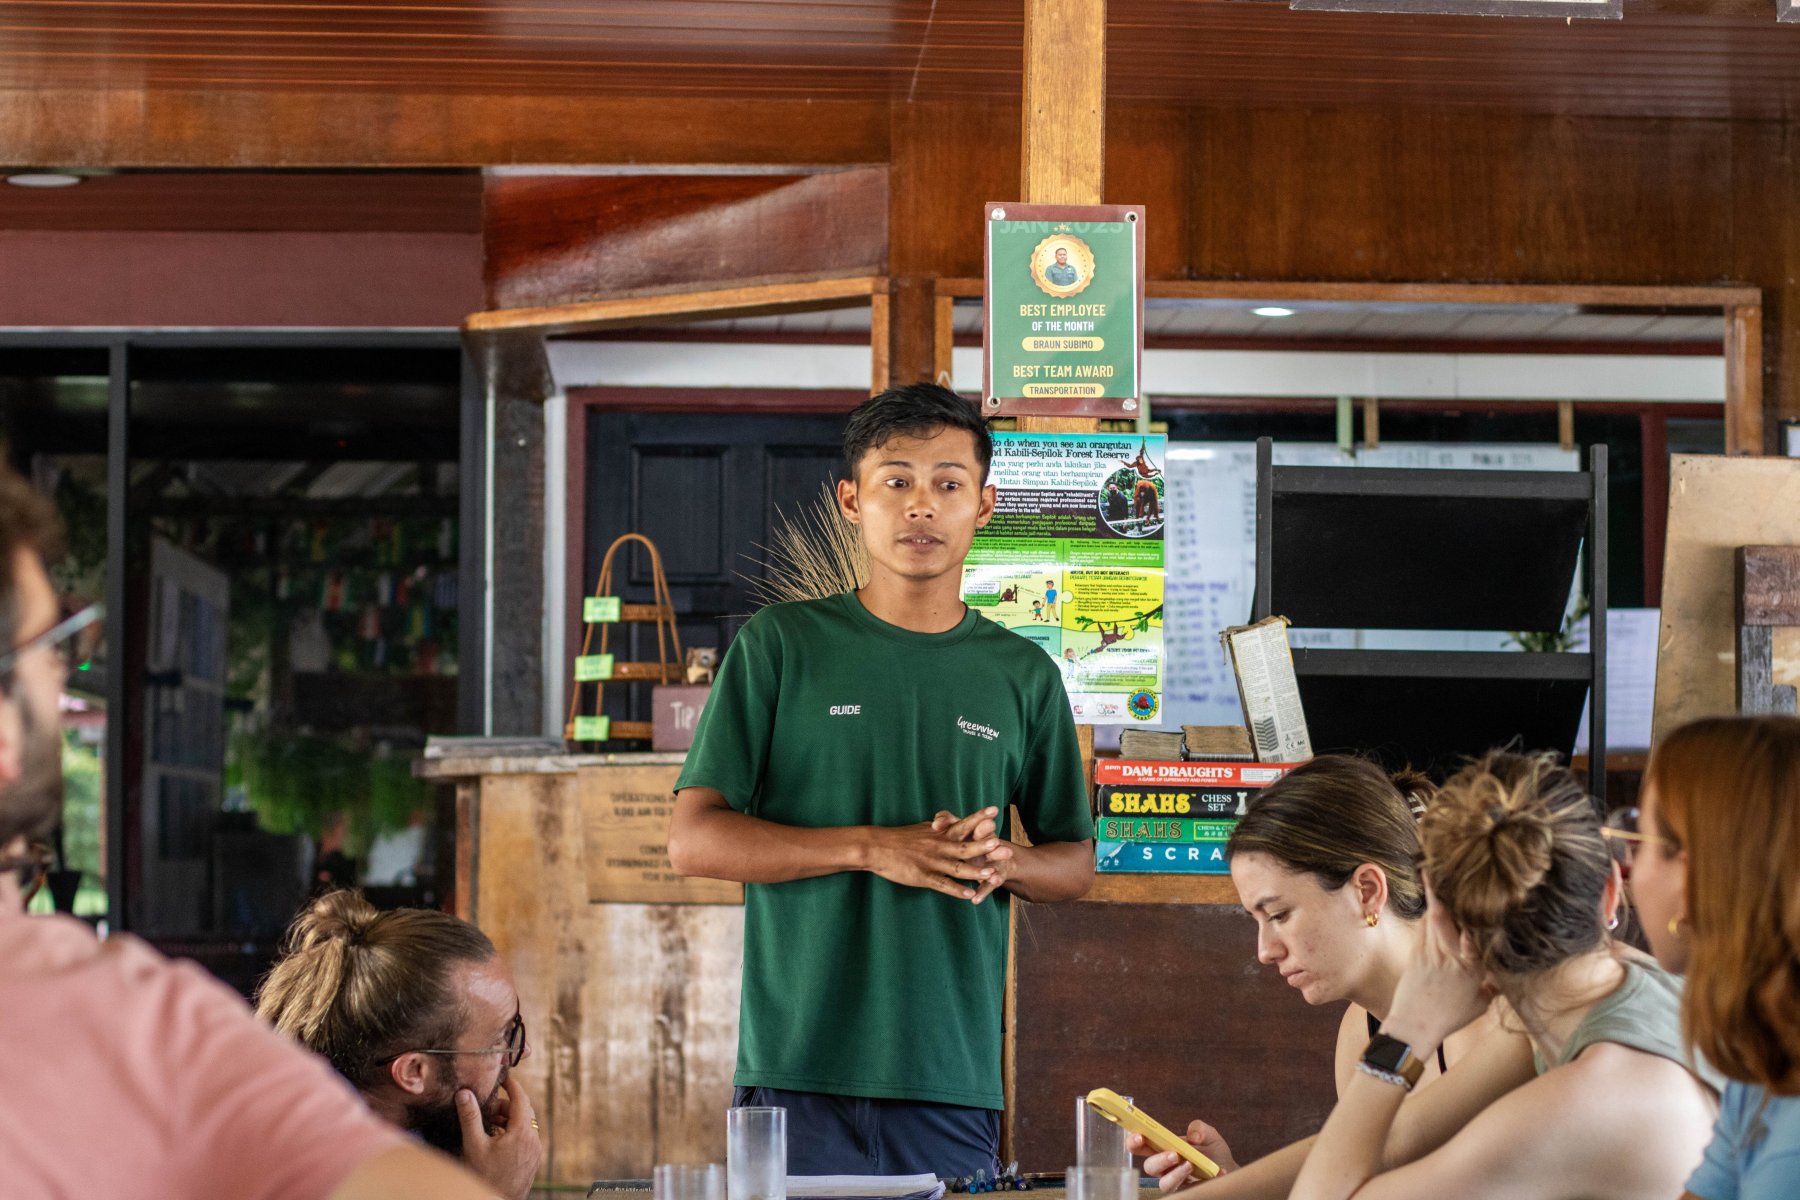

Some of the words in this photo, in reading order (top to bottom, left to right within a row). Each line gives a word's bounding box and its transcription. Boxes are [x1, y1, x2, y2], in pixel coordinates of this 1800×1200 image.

[1020, 304, 1047, 316] BEST
[1050, 304, 1106, 316] EMPLOYEE
[1032, 321, 1043, 331] OF
[1046, 321, 1062, 331] THE
[1065, 321, 1094, 331] MONTH
[1033, 340, 1060, 349] BRAUN
[1063, 340, 1093, 349] SUBIMO
[1013, 365, 1039, 377] BEST
[1043, 365, 1072, 377] TEAM
[1075, 365, 1114, 377] AWARD
[1030, 386, 1096, 395] TRANSPORTATION
[1004, 439, 1014, 447] do
[1017, 439, 1040, 448] when
[1042, 441, 1058, 450] you
[1089, 441, 1132, 451] orangutan
[1004, 448, 1063, 459] Kabili-Sepilok
[1065, 449, 1093, 458] Forest
[1095, 450, 1130, 459] Reserve
[991, 460, 1006, 468] Apa
[1007, 461, 1024, 469] yang
[1064, 461, 1092, 469] lakukan
[1093, 461, 1107, 470] jika
[1021, 470, 1041, 478] orang
[1060, 470, 1104, 479] berhampiran
[999, 478, 1021, 486] Hutan
[1022, 478, 1049, 487] Simpan
[1050, 479, 1098, 488] Kabili-Sepilok
[829, 705, 861, 715] GUIDE
[957, 715, 1000, 738] Greenview
[1109, 792, 1190, 813] SHAHS
[1202, 794, 1232, 803] CHESS
[1208, 803, 1226, 812] SET
[1106, 821, 1182, 839] SHAHS
